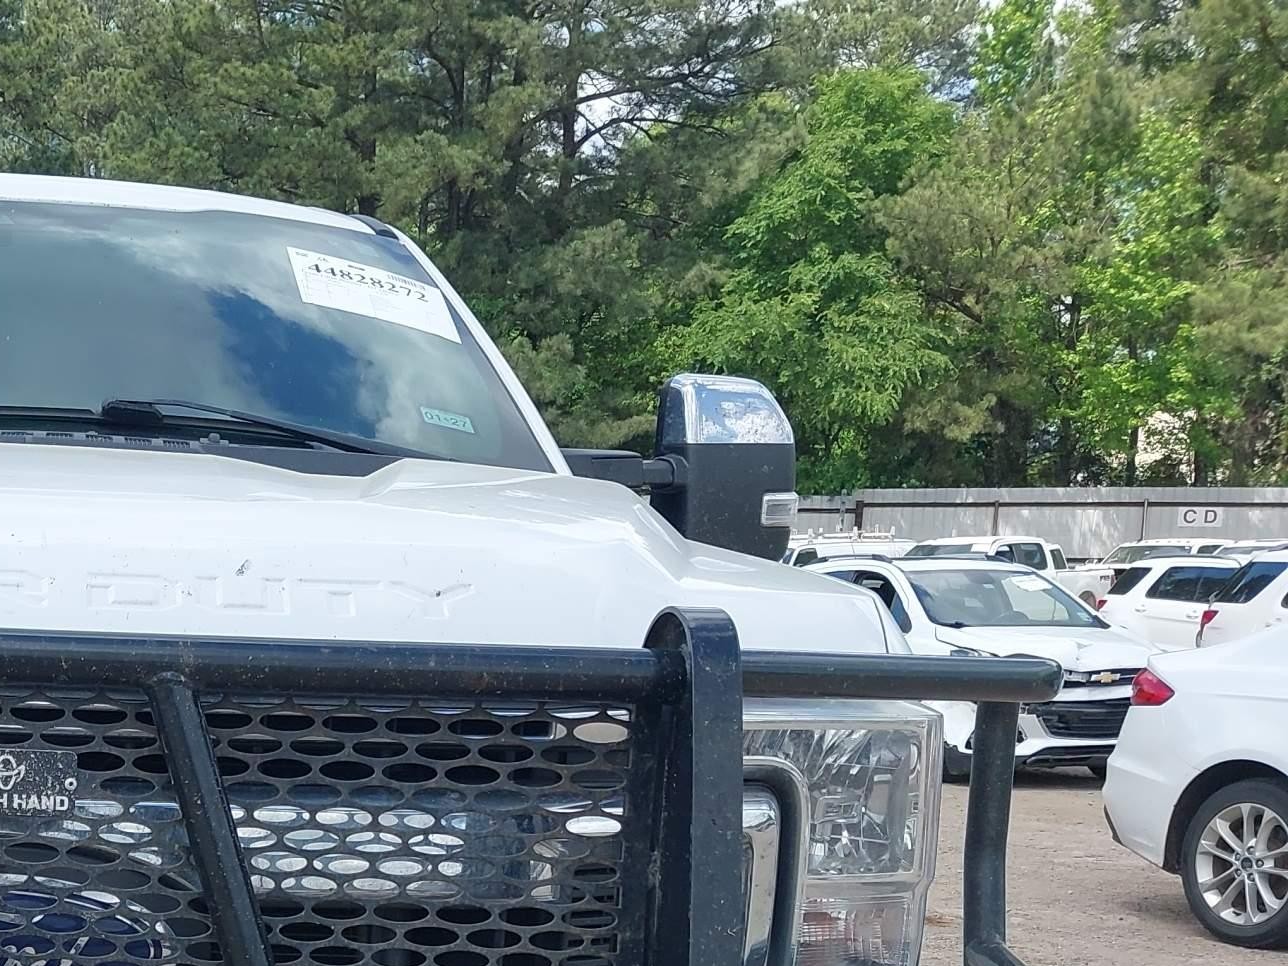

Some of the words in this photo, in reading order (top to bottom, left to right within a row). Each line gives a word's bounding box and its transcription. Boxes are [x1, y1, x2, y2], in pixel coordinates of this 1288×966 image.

[307, 262, 430, 304] 44828272
[84, 569, 478, 620] DUTY
[12, 793, 70, 812] HAND
